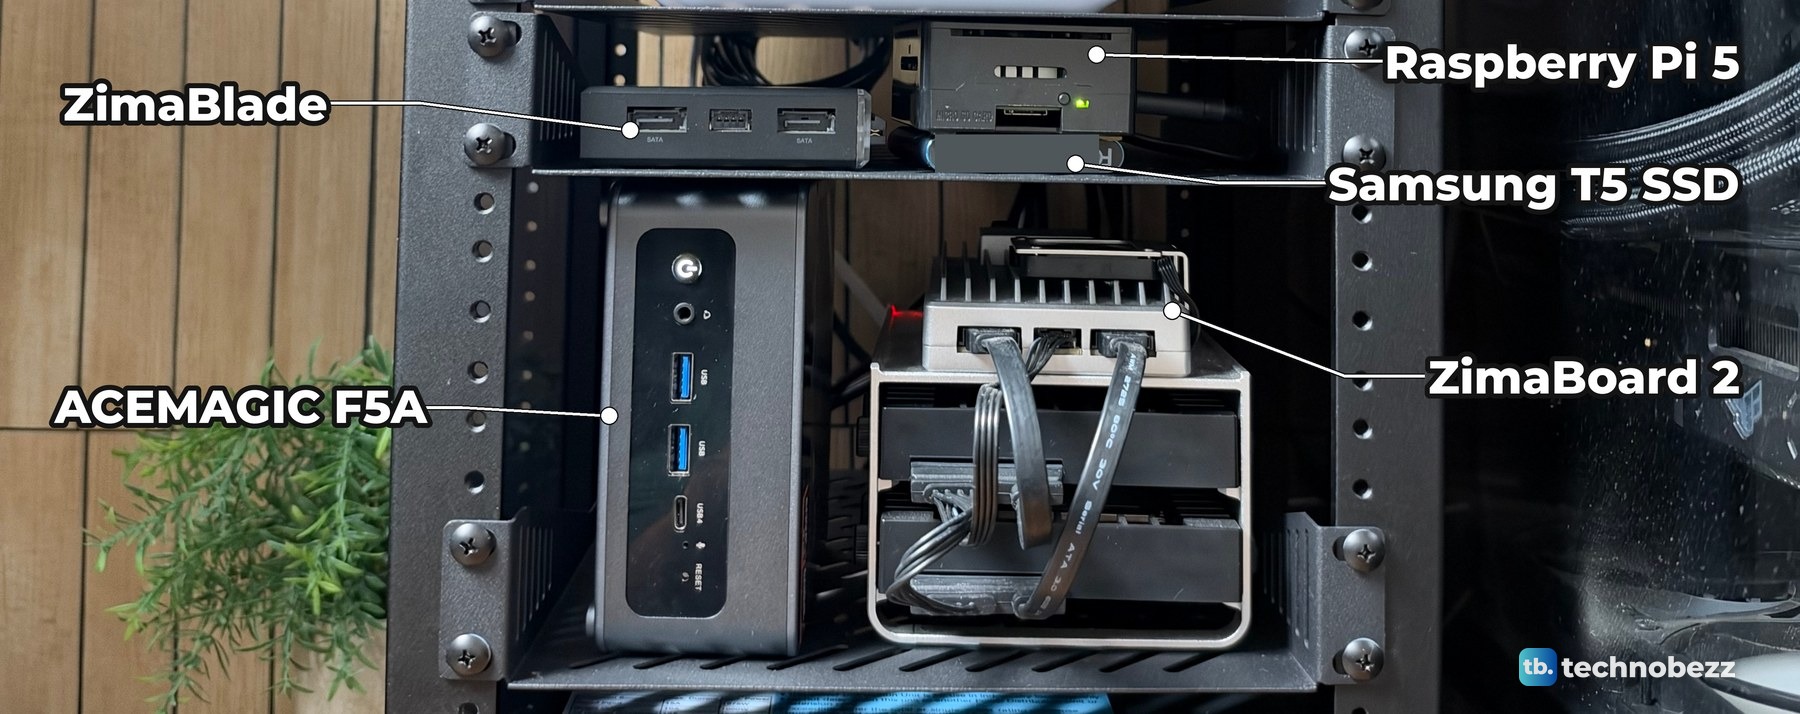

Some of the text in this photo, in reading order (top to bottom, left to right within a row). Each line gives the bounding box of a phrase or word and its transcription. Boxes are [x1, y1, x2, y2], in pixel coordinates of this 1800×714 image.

[700, 369, 708, 386] USB
[1118, 375, 1131, 406] 2725
[698, 440, 706, 457] USB
[1092, 458, 1107, 491] 30V
[696, 502, 704, 524] USB4
[1075, 500, 1092, 535] Serial
[1060, 542, 1075, 569] ATA
[694, 563, 703, 592] RESET
